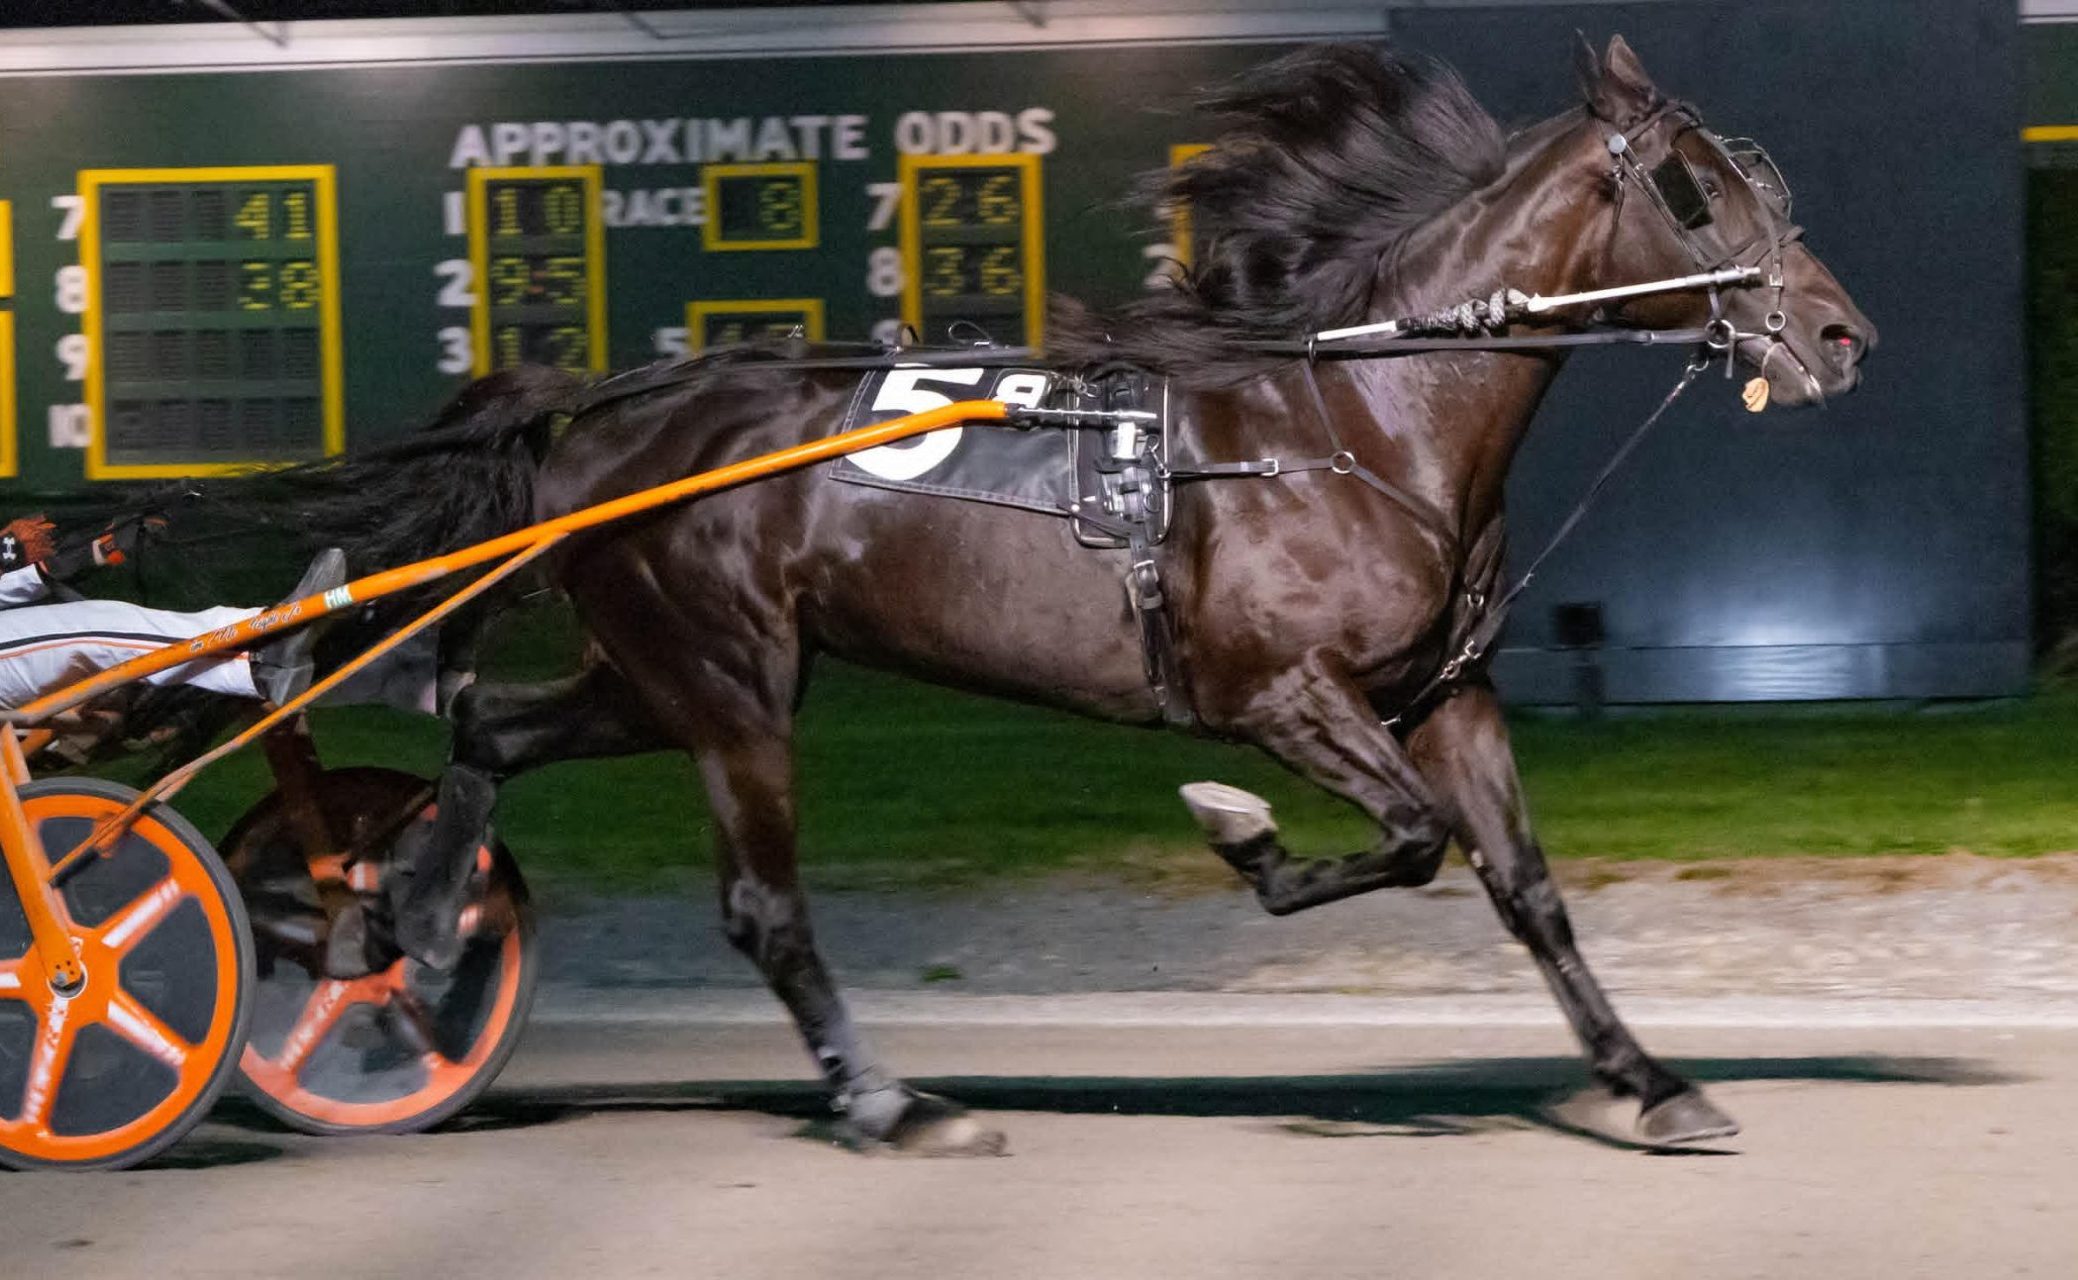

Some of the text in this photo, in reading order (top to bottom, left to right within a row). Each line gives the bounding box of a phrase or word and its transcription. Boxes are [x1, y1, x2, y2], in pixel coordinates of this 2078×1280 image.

[450, 108, 1057, 168] APPROXIMATE ODDS
[52, 195, 86, 239] 7
[233, 191, 312, 239] 41
[493, 186, 582, 233] 10
[603, 187, 706, 227] RACE
[760, 182, 804, 230] 8
[866, 183, 903, 230] 7
[921, 176, 1020, 225] 26
[55, 265, 88, 313] 8
[237, 262, 320, 309] 38
[434, 259, 476, 306] 2
[867, 247, 904, 296] 8
[922, 247, 1022, 295] 36
[55, 334, 88, 379] 9
[437, 326, 473, 373] 3
[845, 368, 984, 480] 5
